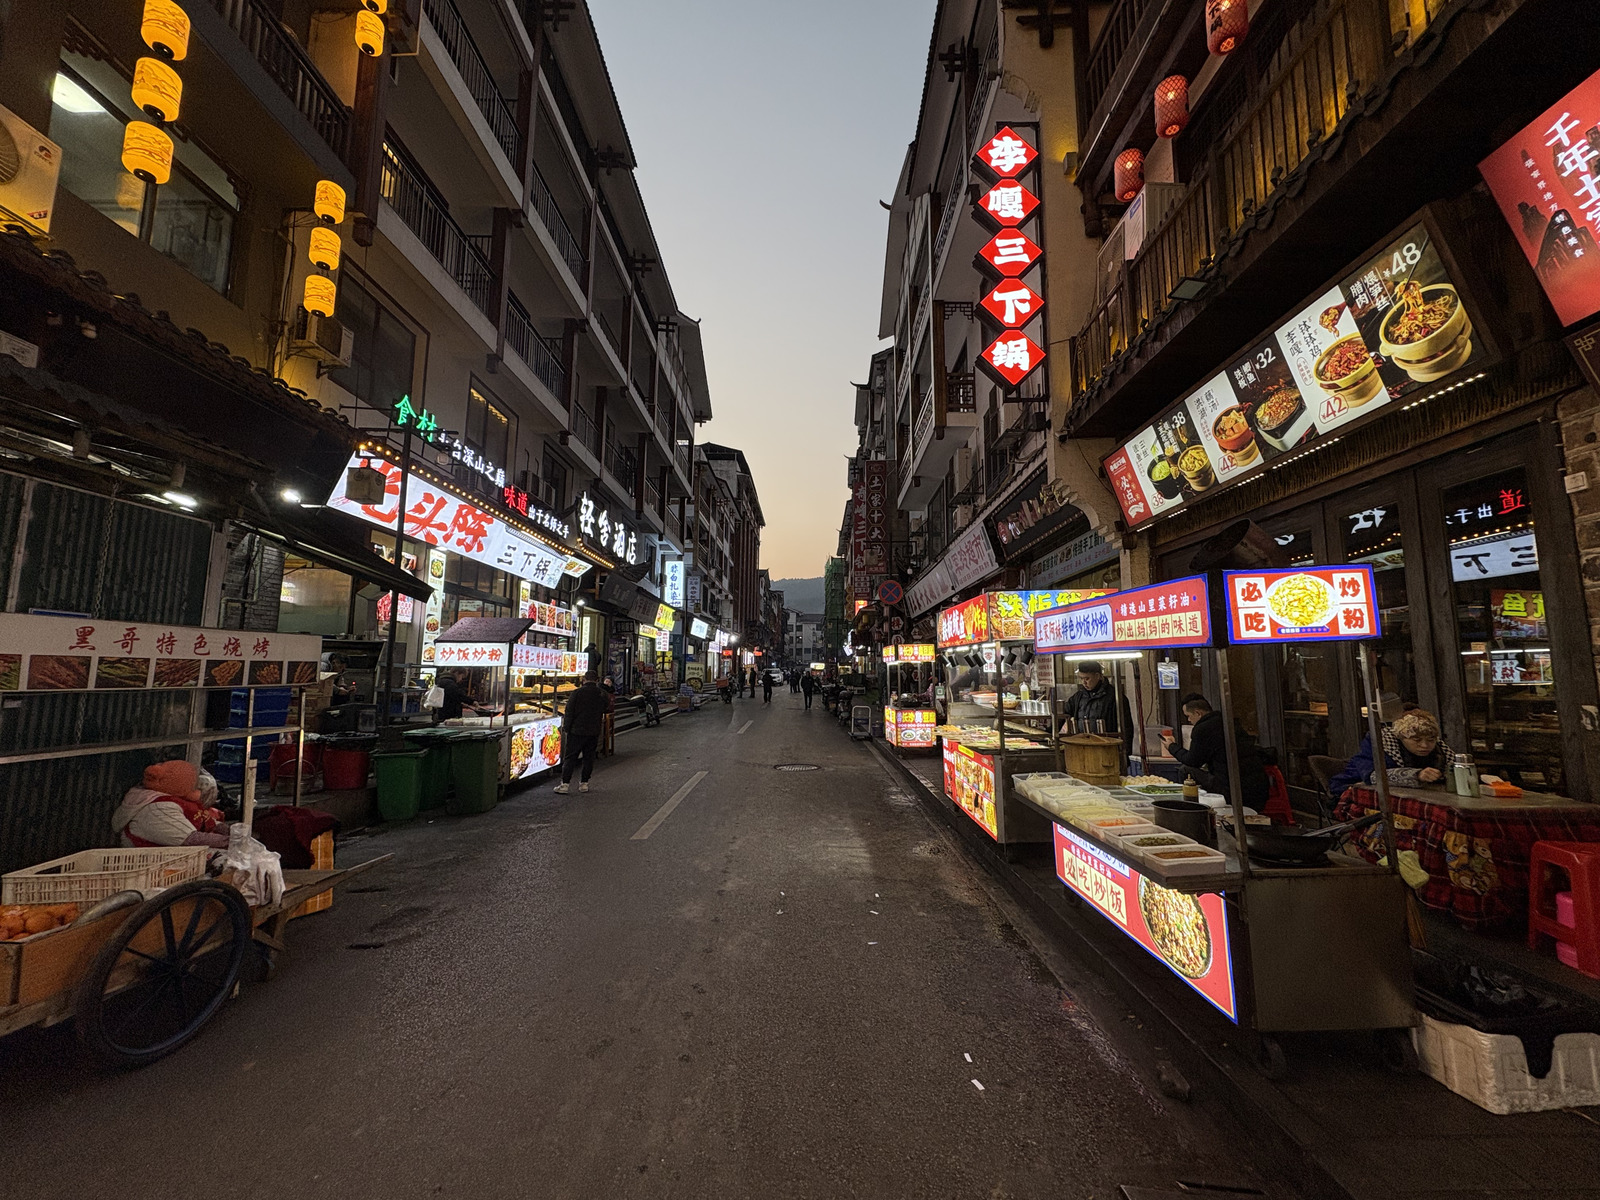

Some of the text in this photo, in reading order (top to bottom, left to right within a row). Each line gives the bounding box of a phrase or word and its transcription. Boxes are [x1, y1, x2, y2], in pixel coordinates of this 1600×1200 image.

[1525, 158, 1584, 259] 张家界地方特色美食
[988, 136, 1031, 371] 李嘎三下锅
[1349, 280, 1370, 309] 腊肉
[1363, 271, 1390, 312] 煨笋丝
[1298, 320, 1322, 360] 钵钵鸡
[395, 394, 438, 442] 食材
[504, 485, 528, 516] 味道
[497, 544, 552, 582] 三下锅
[1120, 594, 1190, 616] 精选山里菜籽油
[1339, 577, 1365, 629] 炒粉
[68, 626, 270, 658] 黑哥特色烧烤
[1115, 613, 1201, 641] 炒出妈妈的味道
[440, 647, 503, 662] 炒饭炒粉
[1066, 856, 1124, 920] 必吃炒饭
